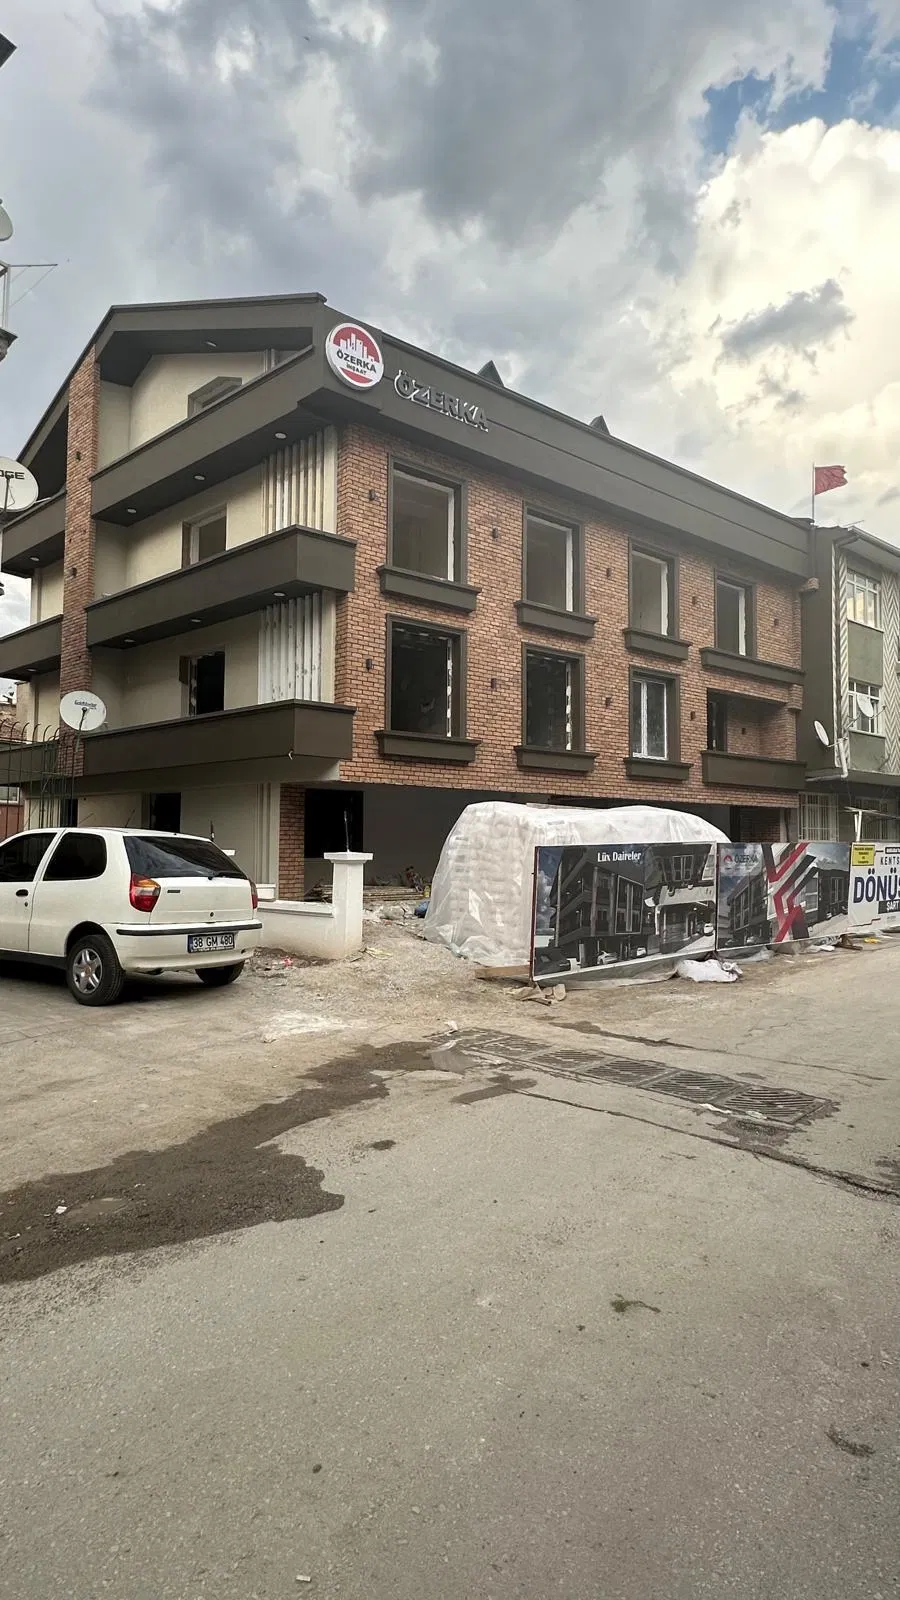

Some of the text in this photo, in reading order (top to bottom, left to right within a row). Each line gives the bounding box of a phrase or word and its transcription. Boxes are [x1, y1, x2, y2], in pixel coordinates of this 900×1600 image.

[336, 349, 377, 373] ÖZERKA
[394, 369, 489, 432] ÖZERKA
[612, 851, 642, 861] Daireler
[193, 935, 233, 948] 38 GM 480
